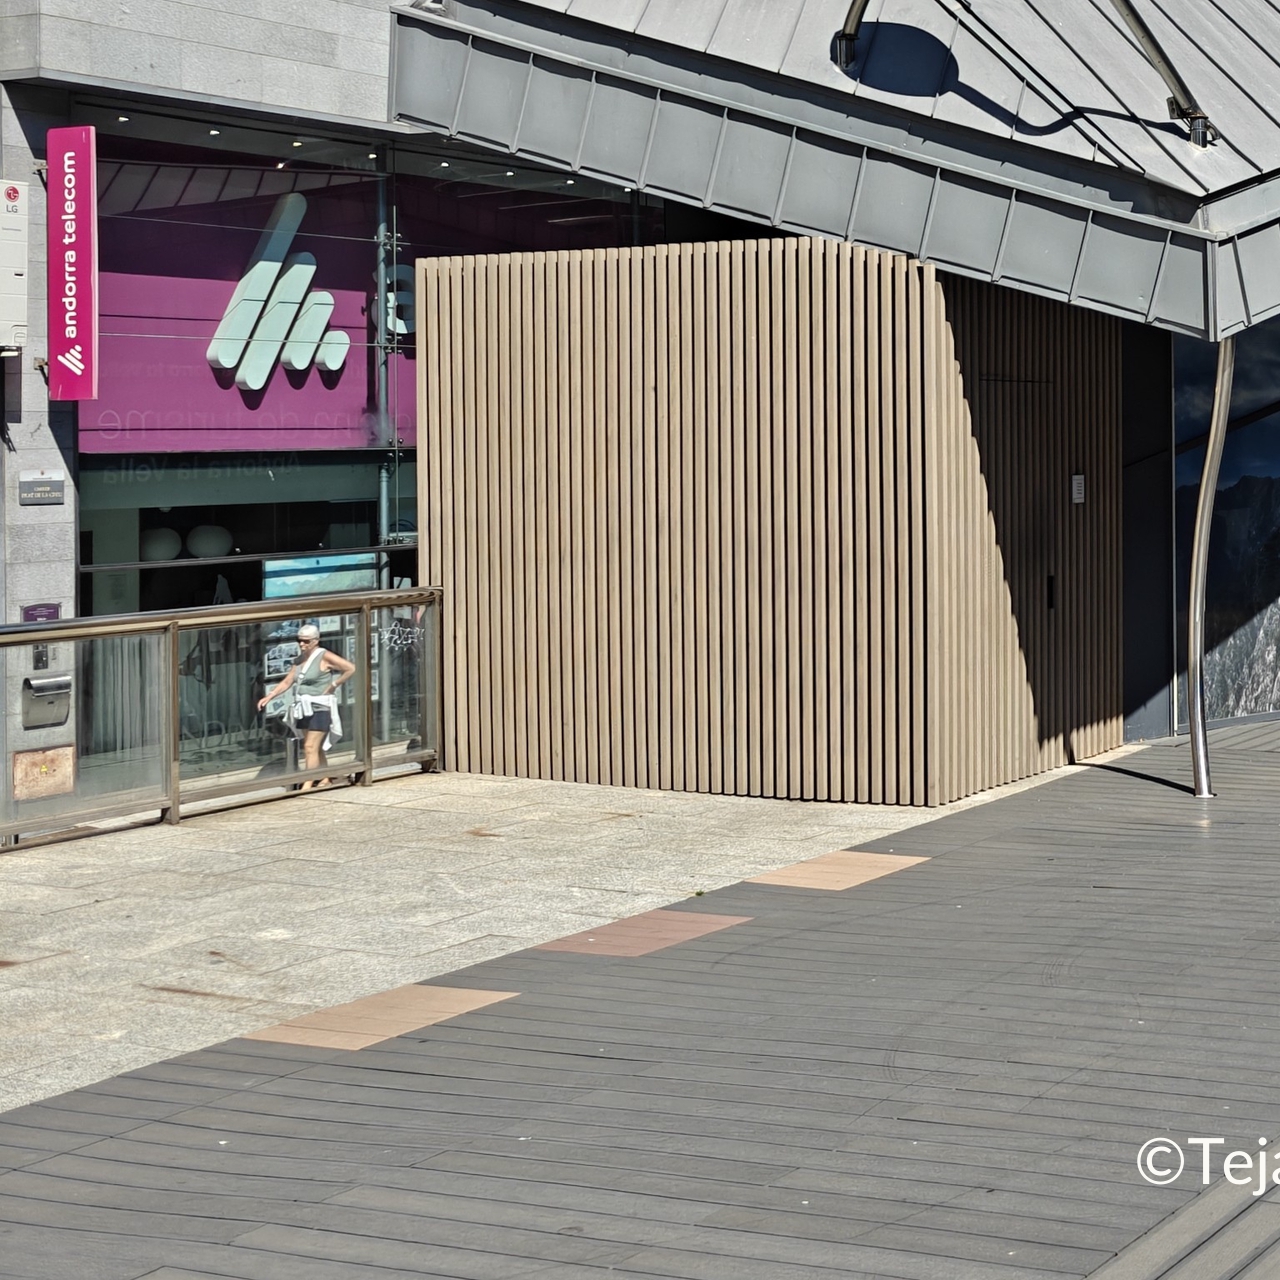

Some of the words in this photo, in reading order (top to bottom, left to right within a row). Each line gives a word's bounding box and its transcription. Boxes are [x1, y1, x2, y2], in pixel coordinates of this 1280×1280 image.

[6, 205, 18, 214] LG
[61, 151, 76, 245] telecom
[61, 250, 77, 339] andorra
